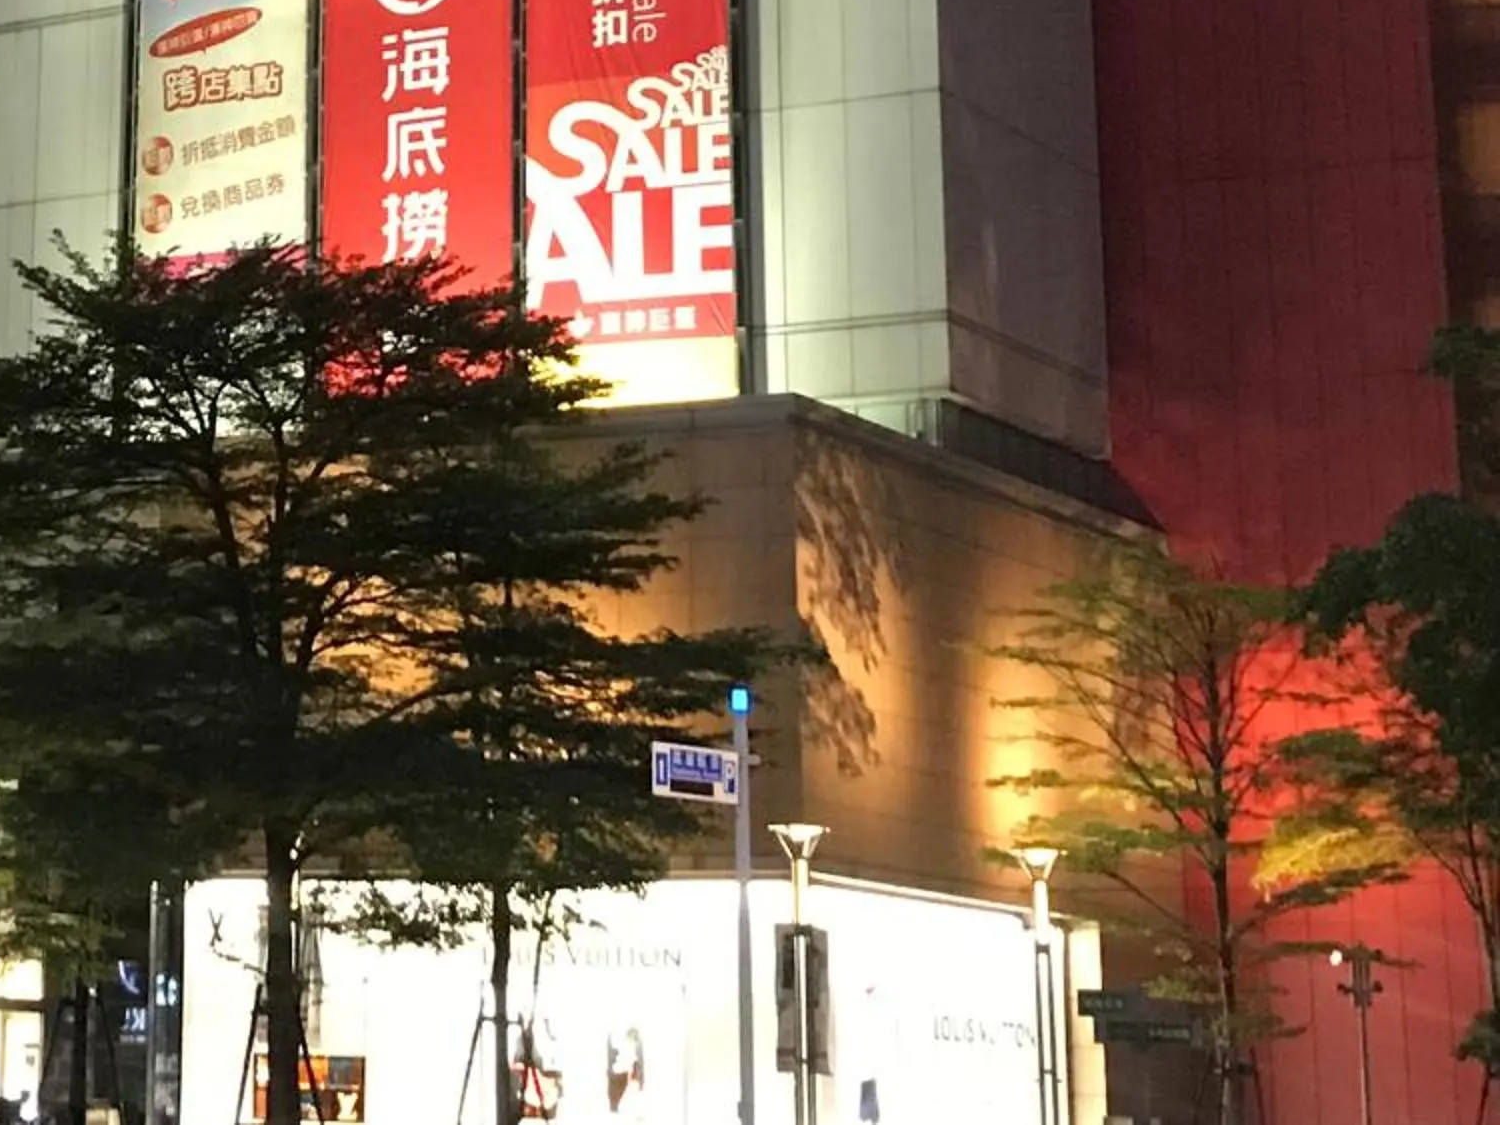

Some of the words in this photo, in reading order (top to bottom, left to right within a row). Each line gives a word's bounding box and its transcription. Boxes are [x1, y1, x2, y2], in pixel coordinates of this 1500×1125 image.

[164, 61, 283, 111] 跨店集點
[627, 76, 730, 130] SALE
[381, 26, 450, 265] 海底撈
[548, 100, 732, 197] SALE
[526, 158, 733, 309] ALE
